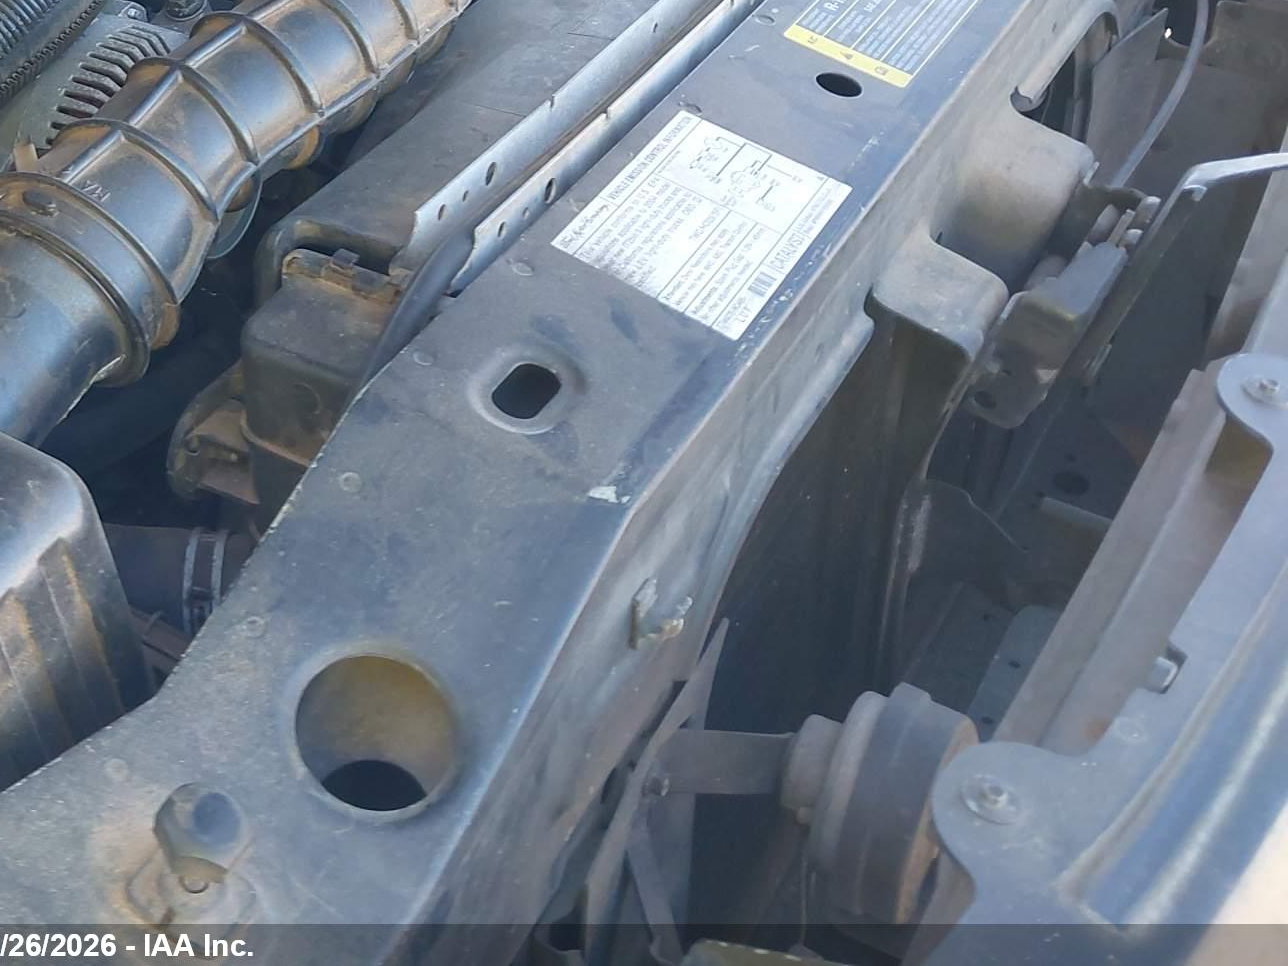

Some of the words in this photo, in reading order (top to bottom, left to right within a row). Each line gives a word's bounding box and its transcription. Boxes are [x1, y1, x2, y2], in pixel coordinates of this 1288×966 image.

[605, 179, 631, 201] VEHICLE
[622, 159, 650, 183] EMISSION
[641, 140, 669, 163] CONTROL
[768, 231, 806, 271] CATALYST
